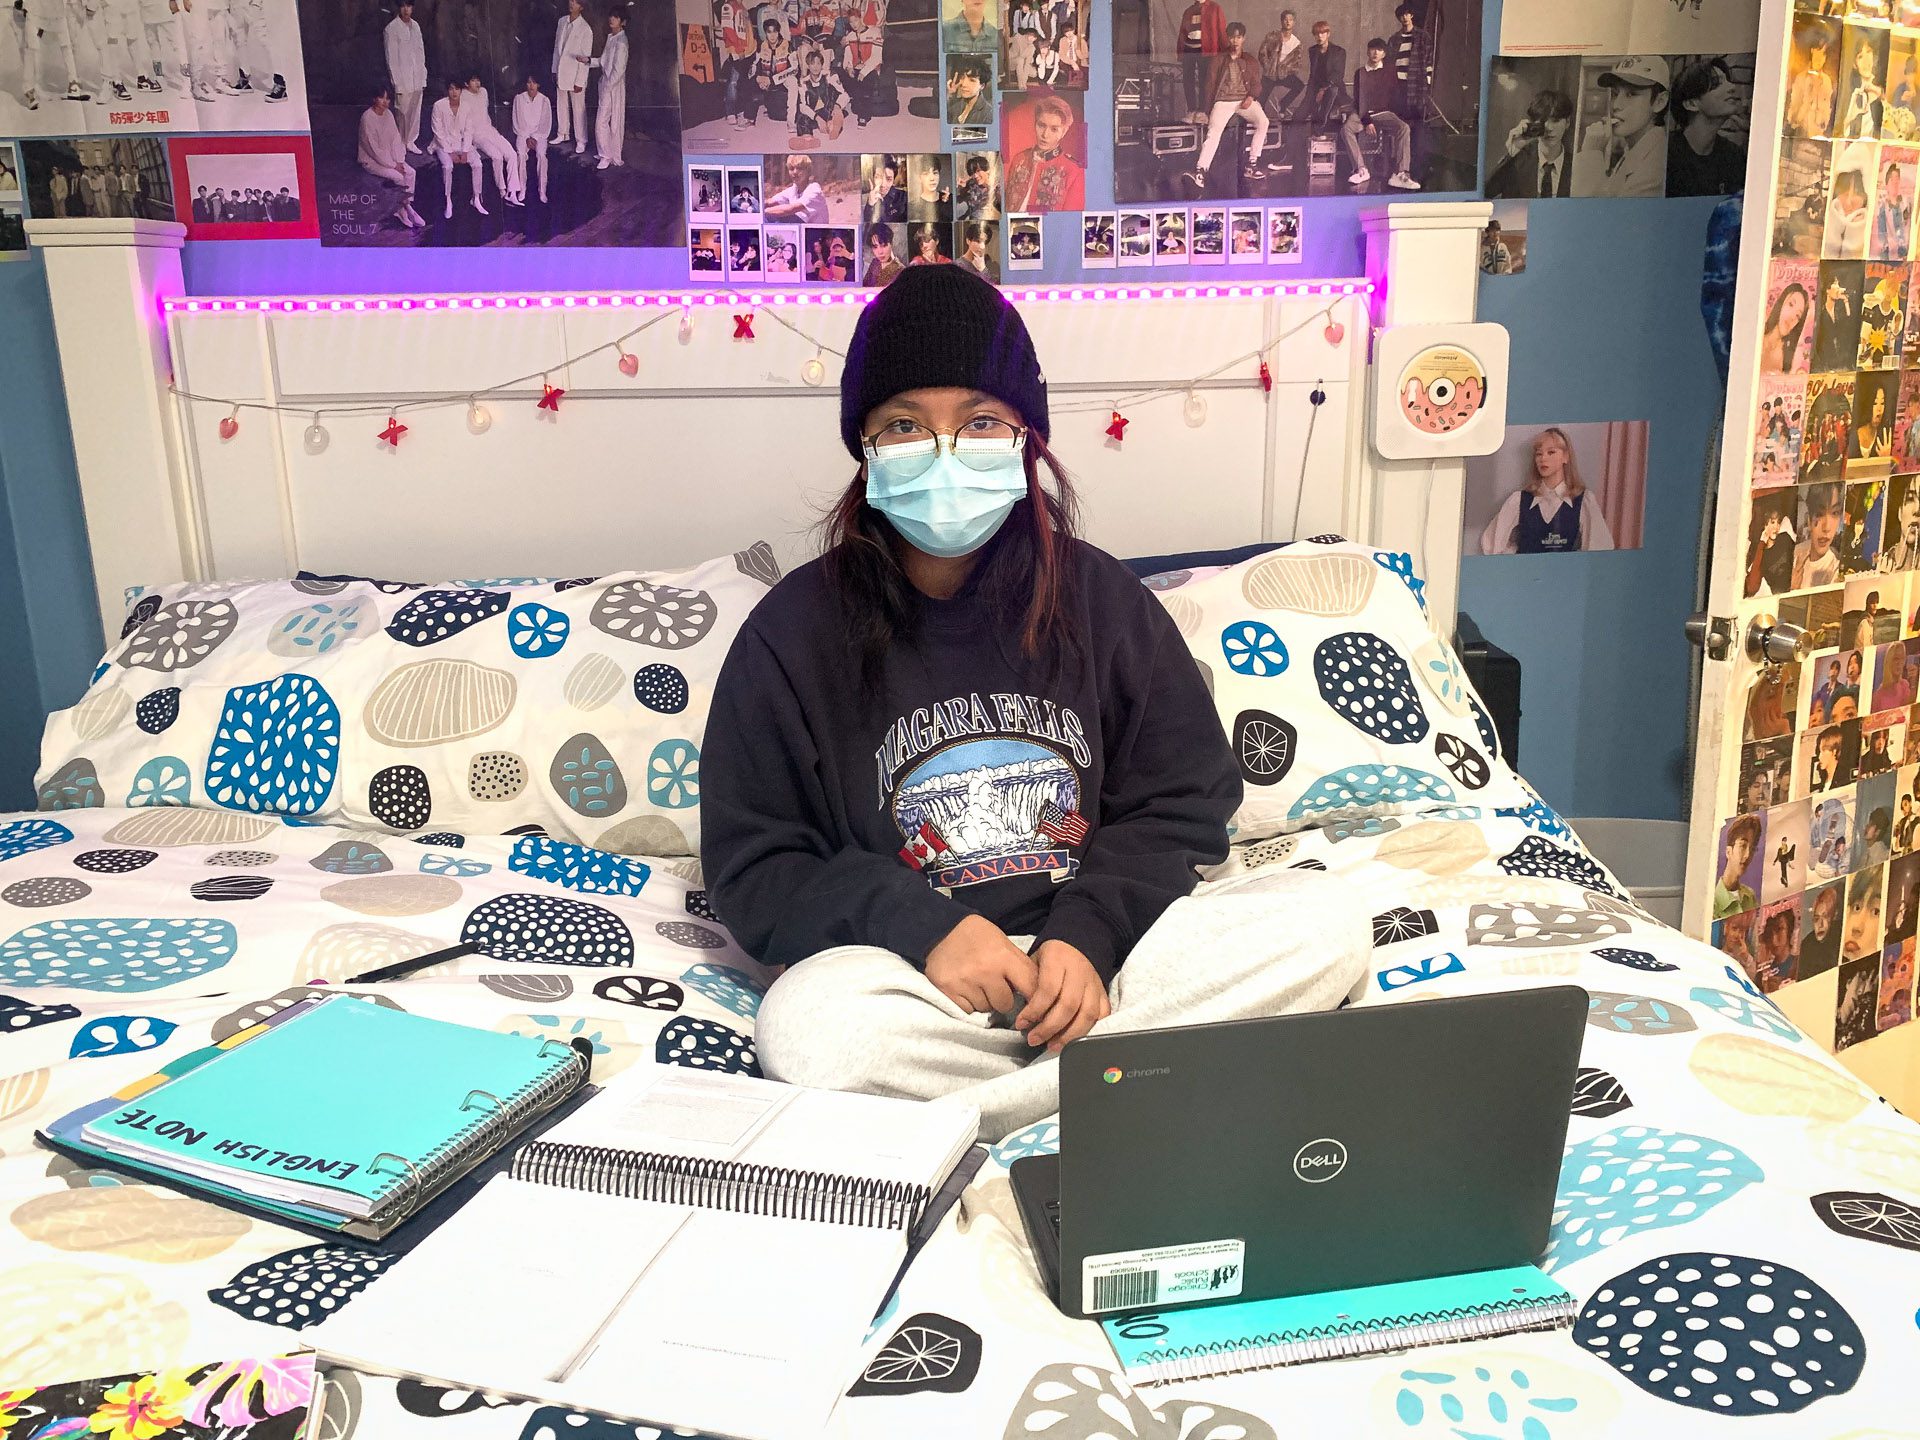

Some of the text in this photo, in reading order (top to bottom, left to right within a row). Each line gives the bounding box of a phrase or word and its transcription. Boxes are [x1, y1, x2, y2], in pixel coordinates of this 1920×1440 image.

[109, 110, 170, 124] 防彈少年團
[329, 194, 377, 205] MAP OF
[331, 209, 355, 220] THE
[332, 223, 377, 235] SOUL 7
[875, 692, 1092, 811] NIAGARA FALLS
[939, 853, 1062, 887] CANADA
[1126, 1066, 1171, 1079] chrome
[114, 1108, 360, 1180] ENGLISH NOTE
[1300, 1152, 1341, 1169] DELL
[1173, 1268, 1209, 1280] Schools
[1167, 1281, 1208, 1292] Chicago
[1179, 1275, 1208, 1286] Public
